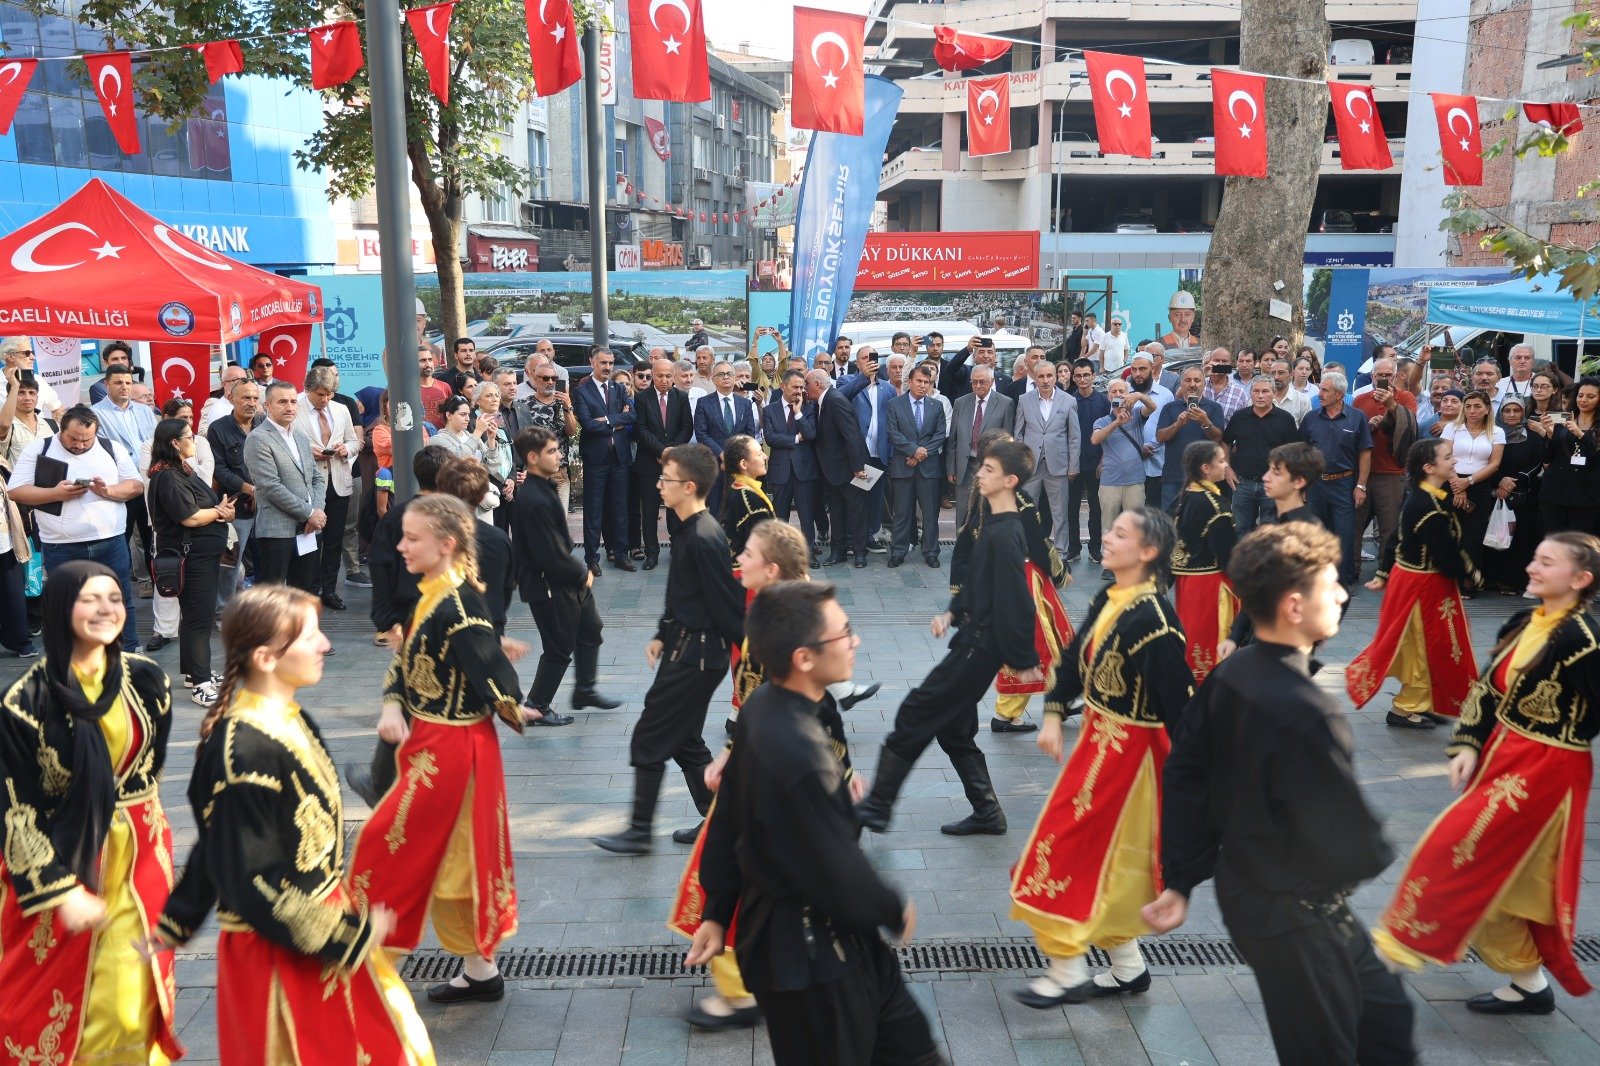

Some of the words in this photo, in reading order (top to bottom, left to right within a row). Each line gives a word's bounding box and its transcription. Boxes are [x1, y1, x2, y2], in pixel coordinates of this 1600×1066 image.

[945, 81, 967, 91] KAT
[173, 225, 250, 252] KBANK
[860, 247, 881, 261] AY
[886, 243, 962, 261] DÜKKANI
[54, 308, 130, 328] VALİLİĞİ
